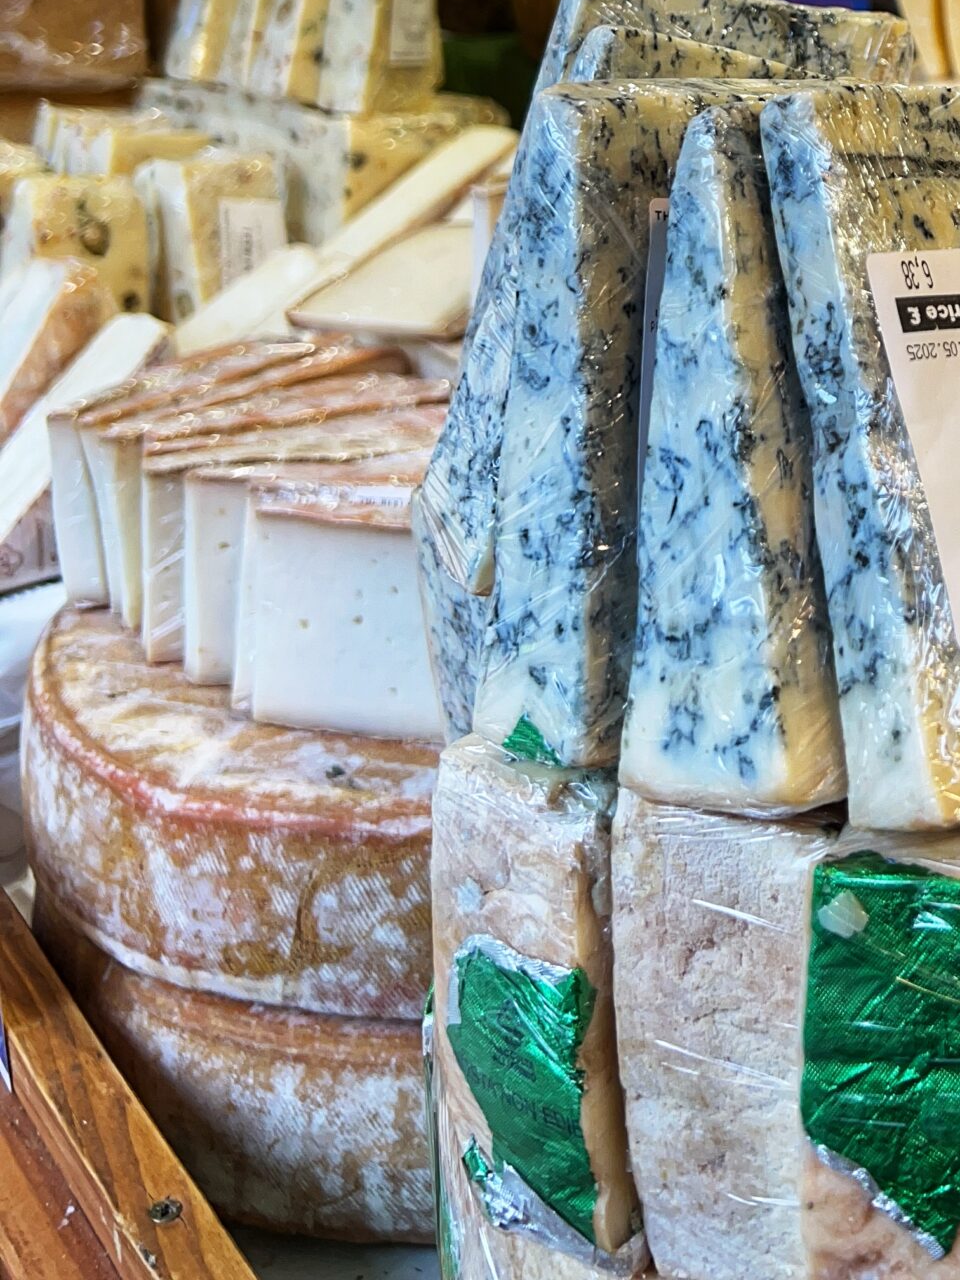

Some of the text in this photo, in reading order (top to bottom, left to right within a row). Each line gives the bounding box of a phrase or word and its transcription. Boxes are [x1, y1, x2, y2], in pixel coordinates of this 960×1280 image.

[655, 210, 669, 222] TH
[901, 256, 934, 290] 6,38
[907, 306, 921, 325] £
